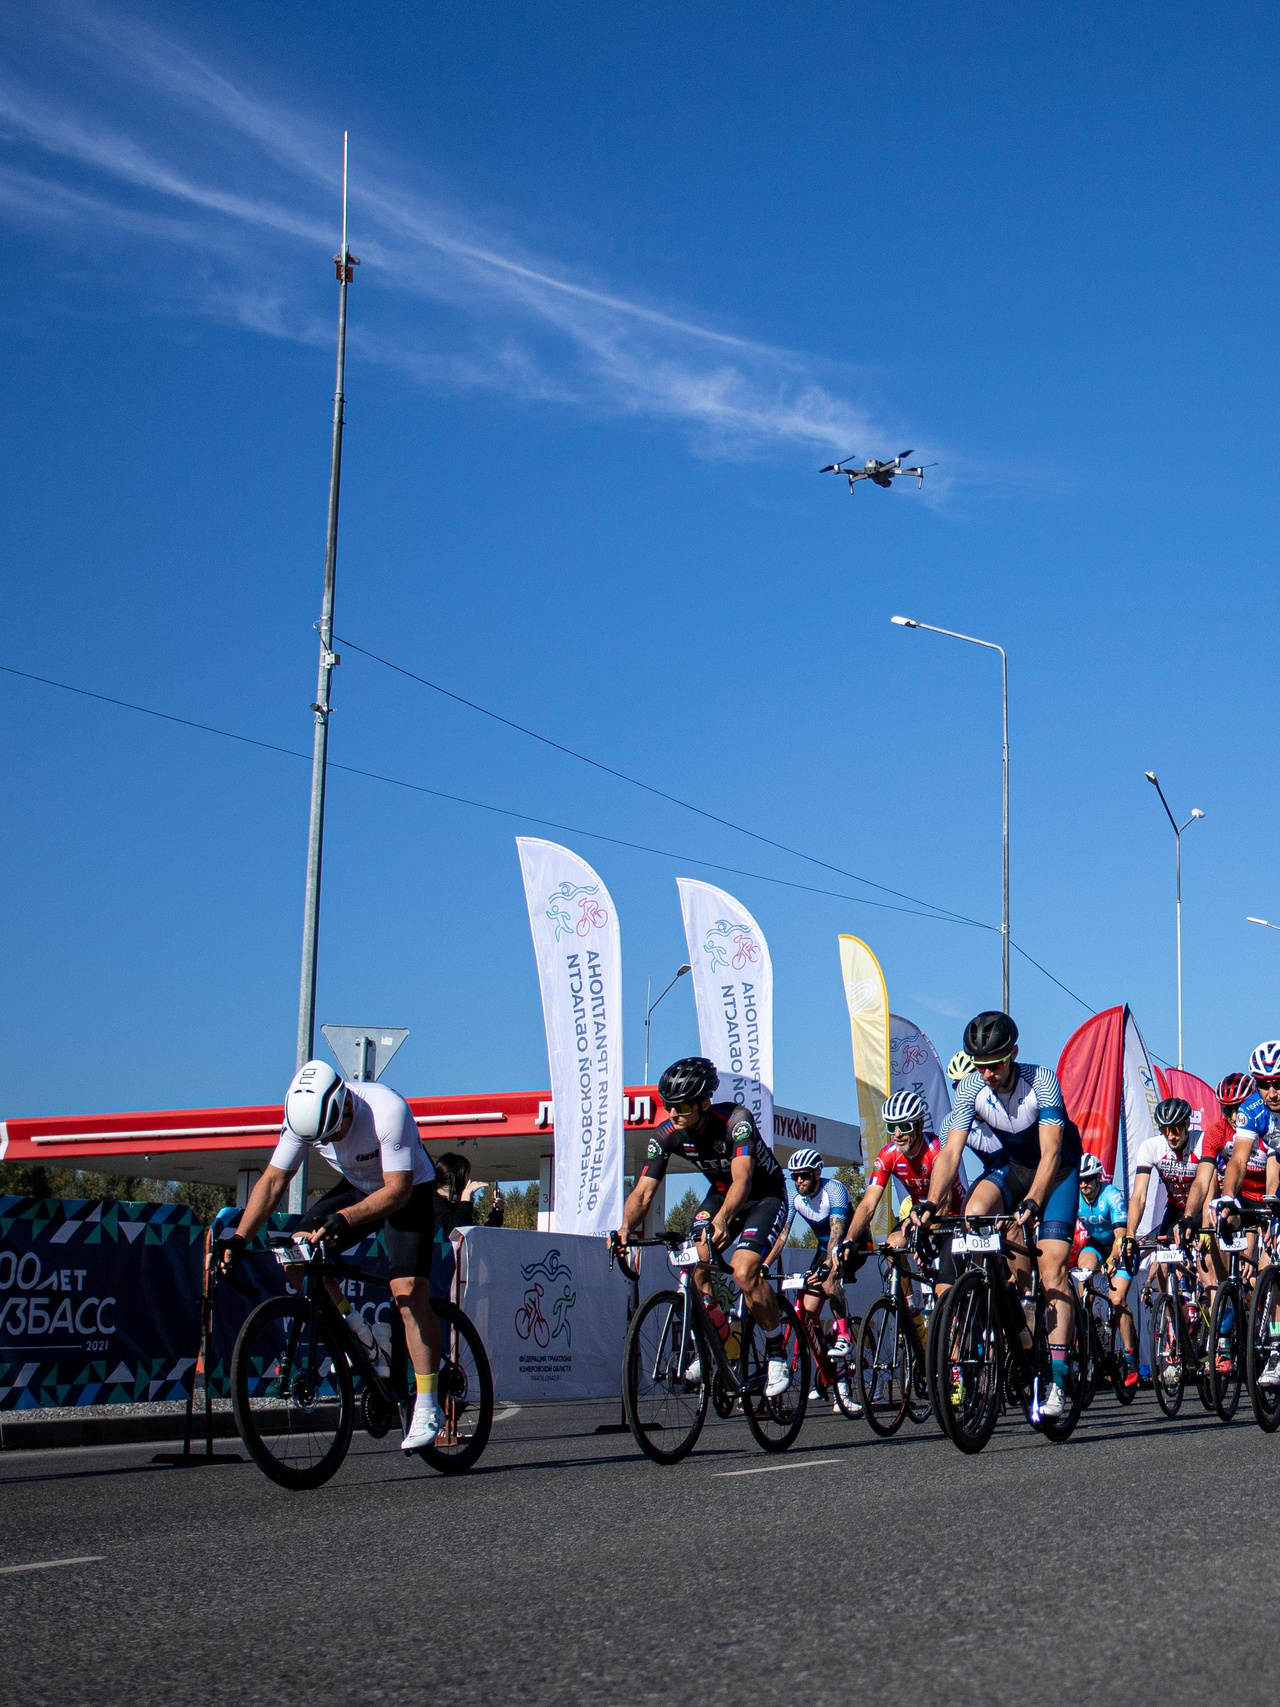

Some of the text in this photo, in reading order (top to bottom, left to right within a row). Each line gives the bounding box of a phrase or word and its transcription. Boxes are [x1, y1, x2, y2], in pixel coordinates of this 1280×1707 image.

[774, 1113, 817, 1144] ЛУКОЙЛ
[972, 1238, 991, 1249] 018
[1162, 1252, 1177, 1260] 047
[86, 1340, 109, 1351] 2021
